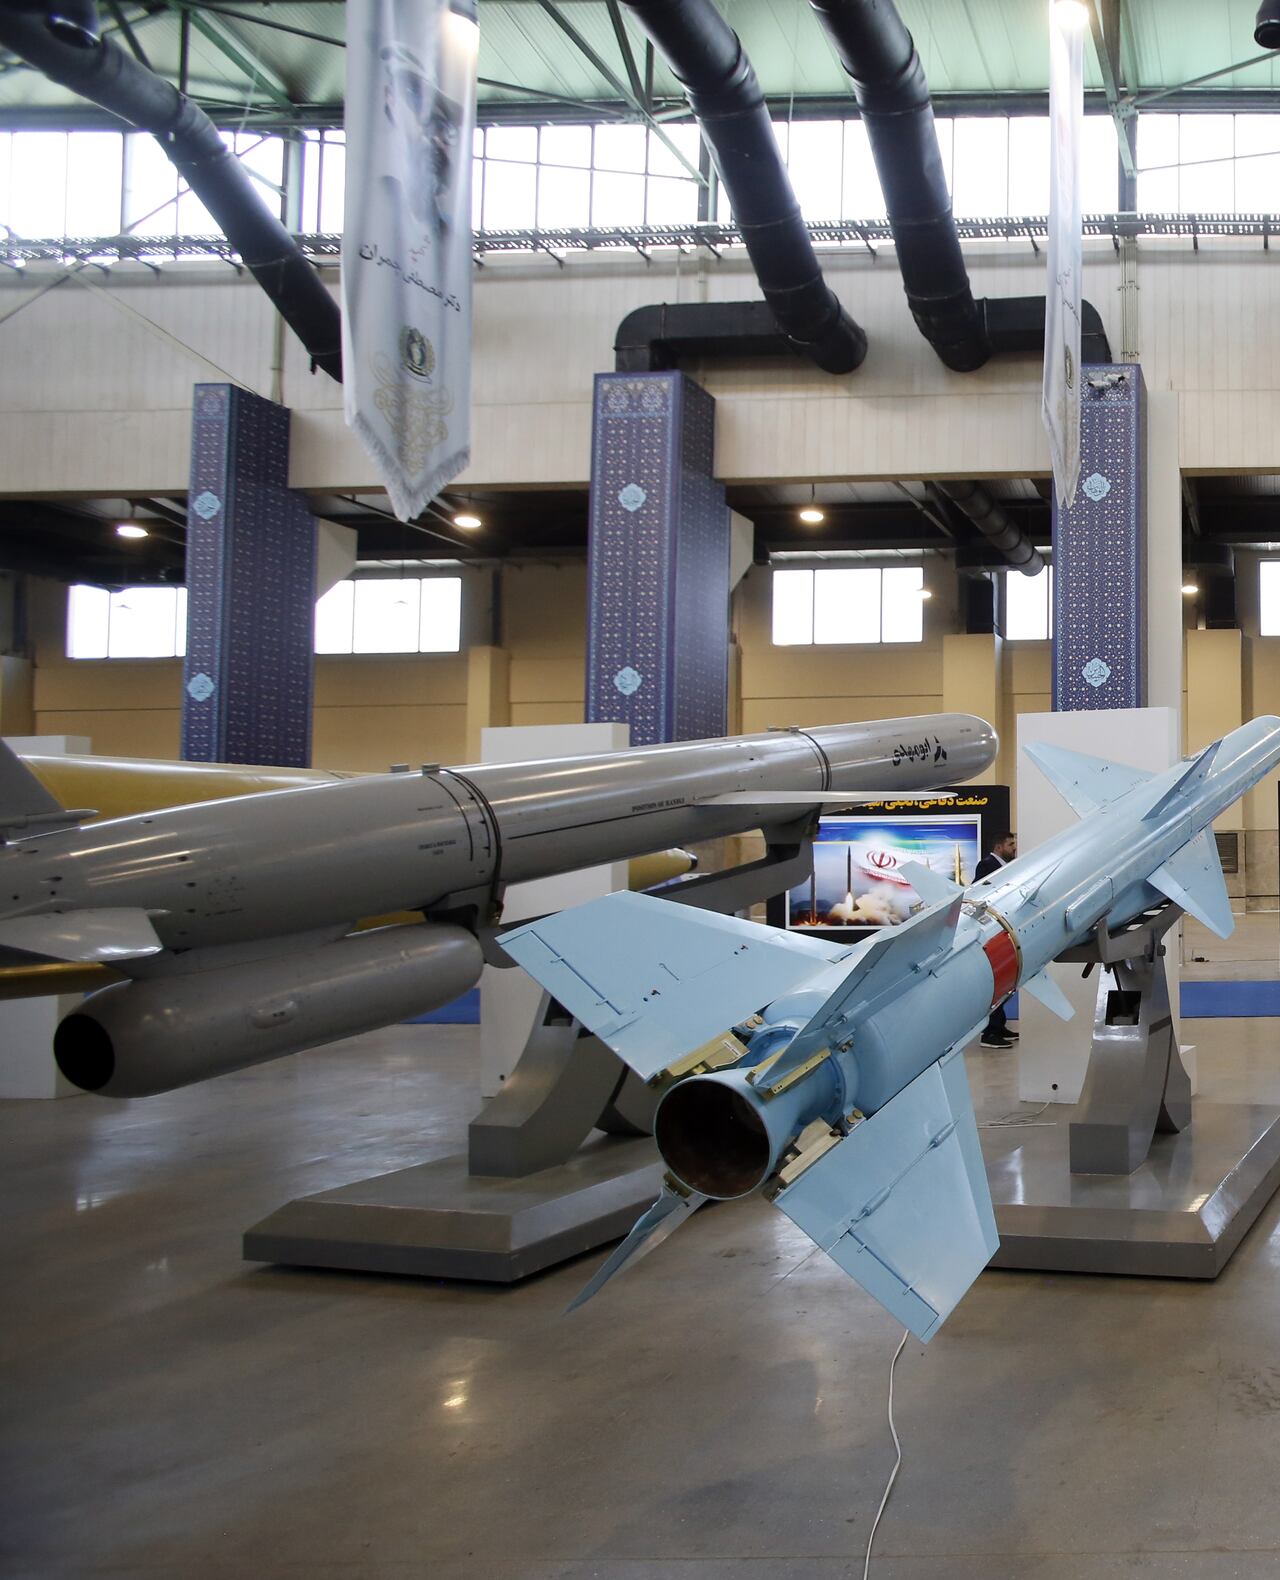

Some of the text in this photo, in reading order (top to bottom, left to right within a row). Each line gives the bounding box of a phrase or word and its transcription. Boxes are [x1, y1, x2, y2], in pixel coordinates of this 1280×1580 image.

[358, 243, 402, 276] چمران
[892, 736, 932, 767] ابومهدی
[956, 795, 988, 806] صنعت
